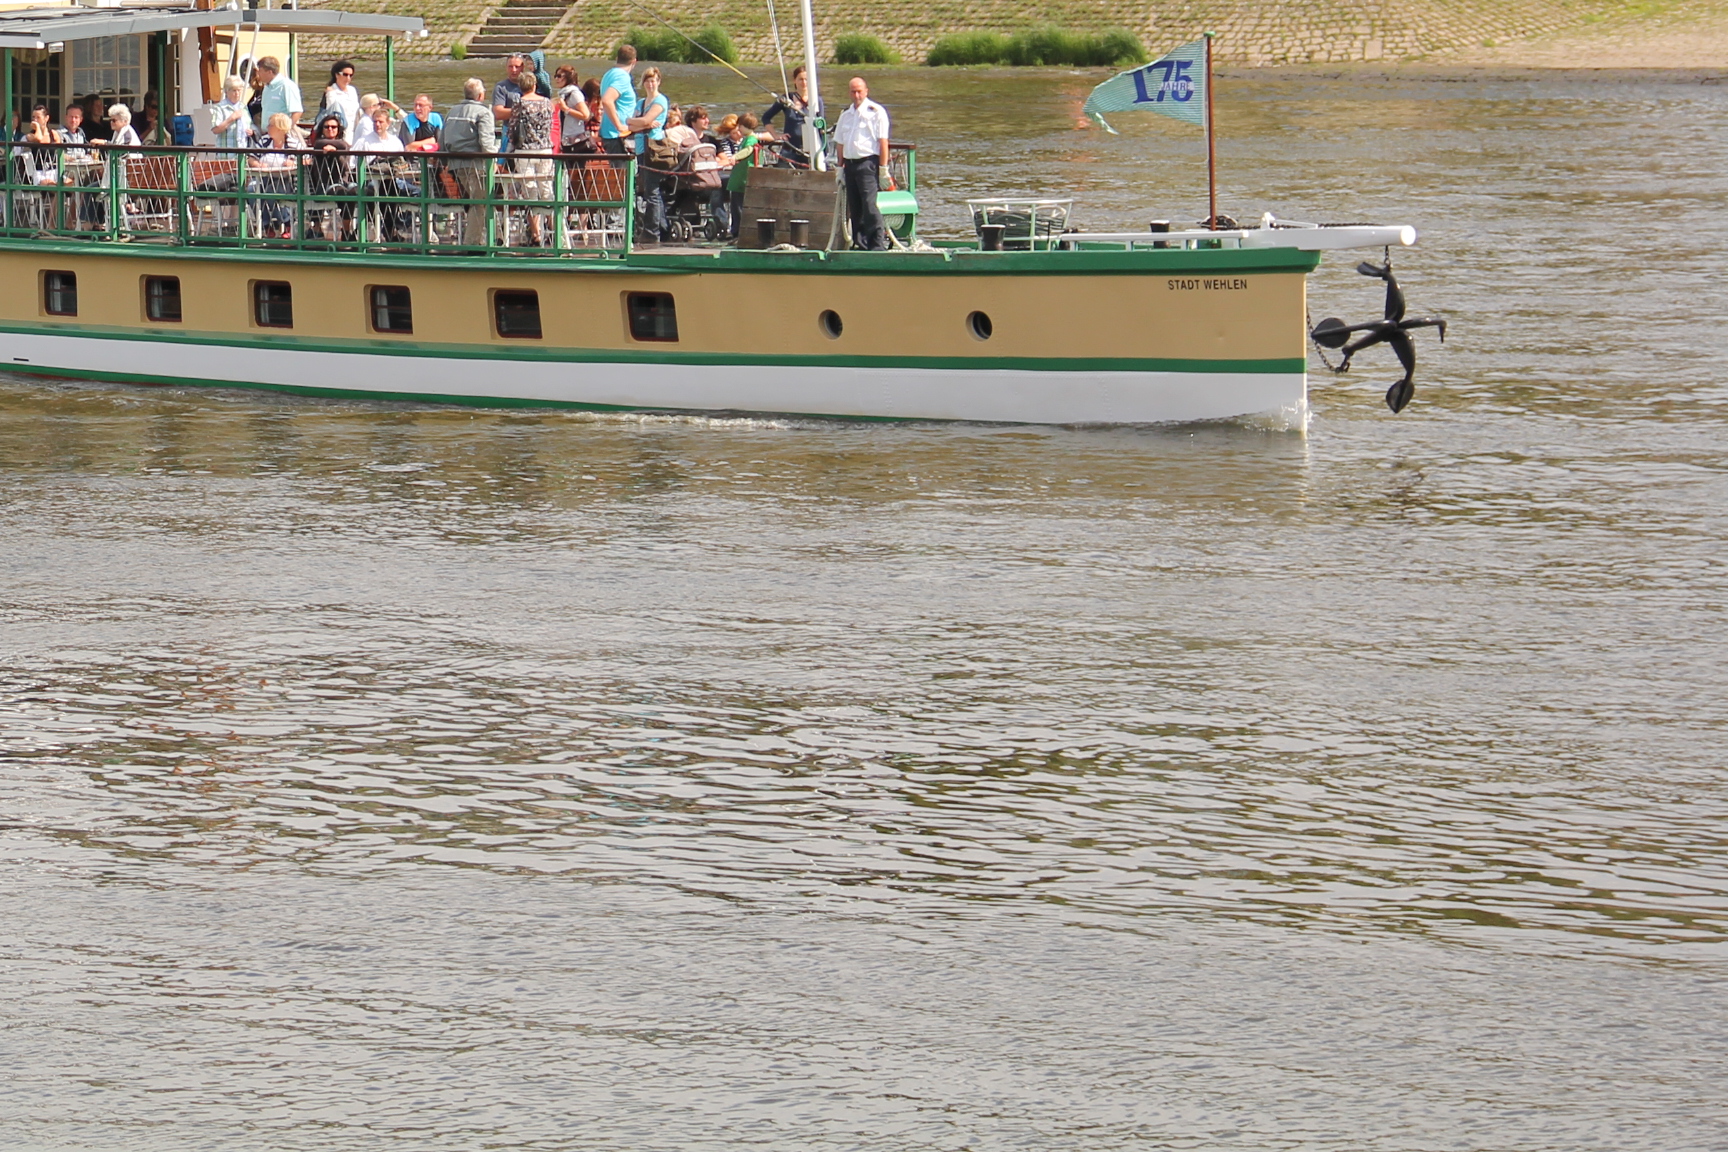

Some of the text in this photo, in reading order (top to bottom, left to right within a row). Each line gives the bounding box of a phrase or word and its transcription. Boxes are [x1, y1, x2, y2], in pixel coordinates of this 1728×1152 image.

[1126, 60, 1194, 103] 175
[1168, 279, 1248, 290] STADT WEHLEN
